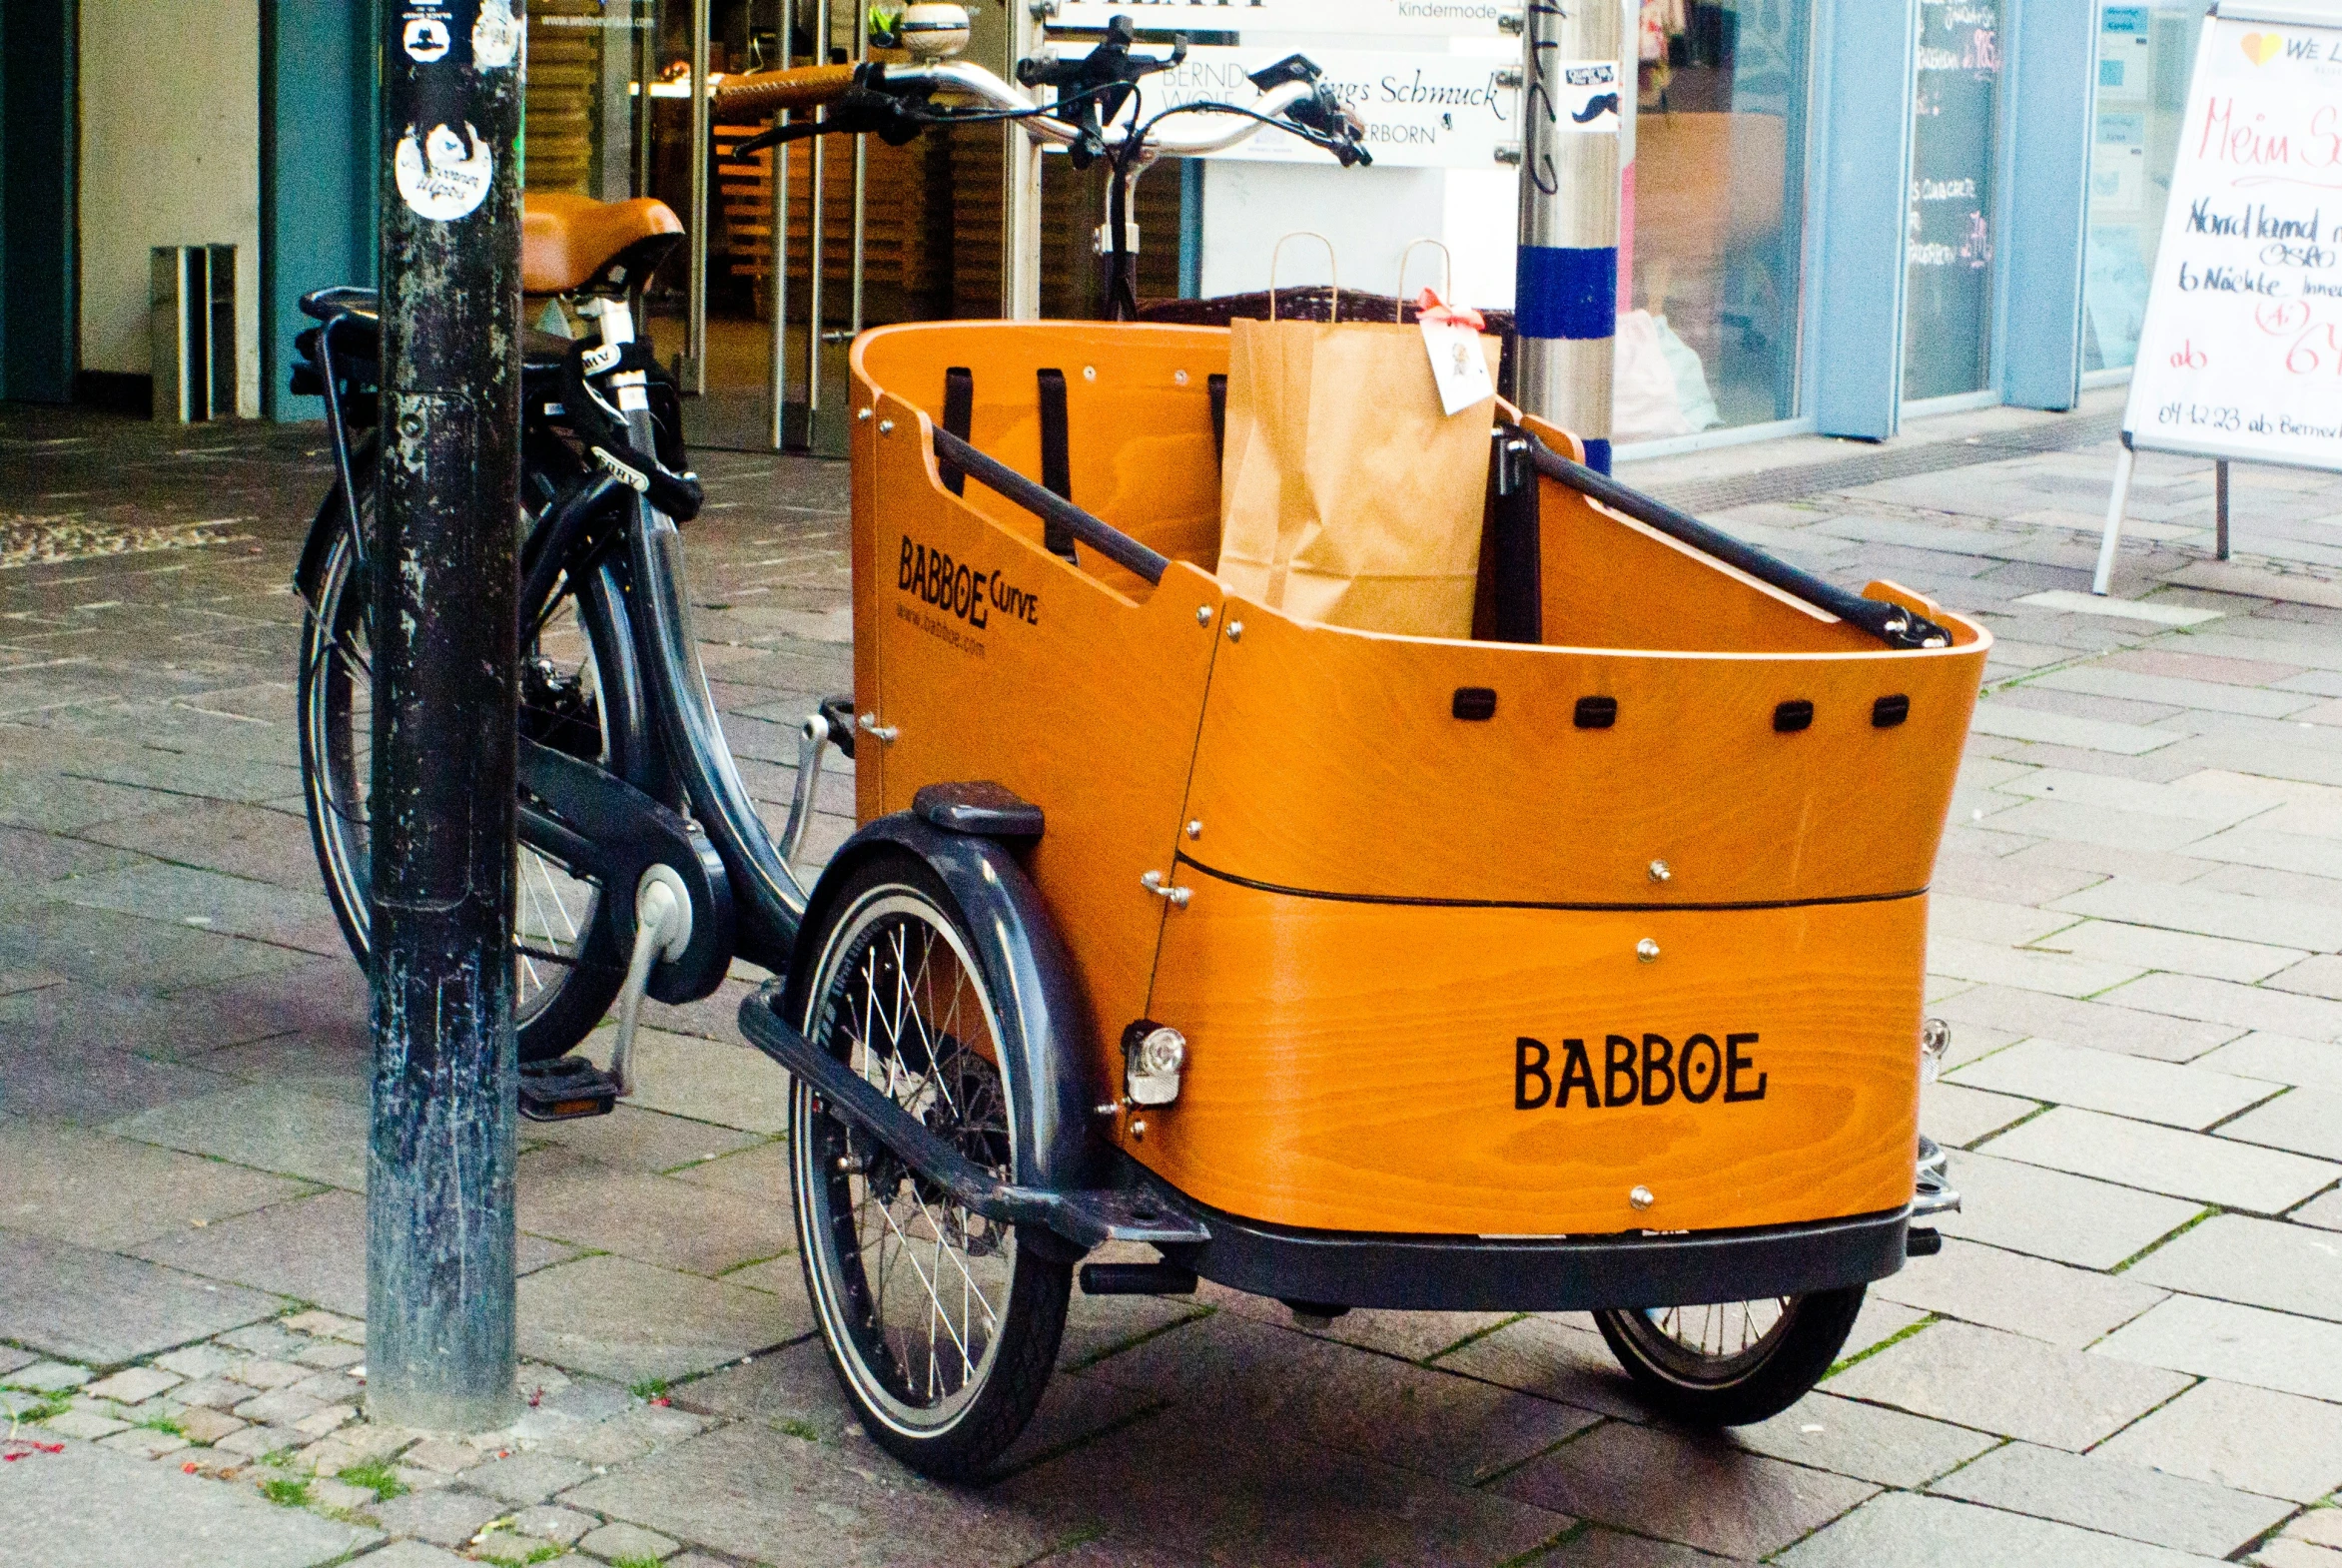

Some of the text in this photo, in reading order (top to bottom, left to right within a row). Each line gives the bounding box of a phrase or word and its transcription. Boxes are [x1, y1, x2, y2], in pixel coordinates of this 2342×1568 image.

[1398, 1, 1497, 19] Kindermode
[2287, 37, 2320, 60] WE
[1163, 61, 1245, 89] BERND
[1381, 69, 1506, 121] Schmuck
[2198, 97, 2288, 165] Mein
[899, 534, 988, 630] BABBOE
[1514, 1032, 1768, 1111] BABBOE
